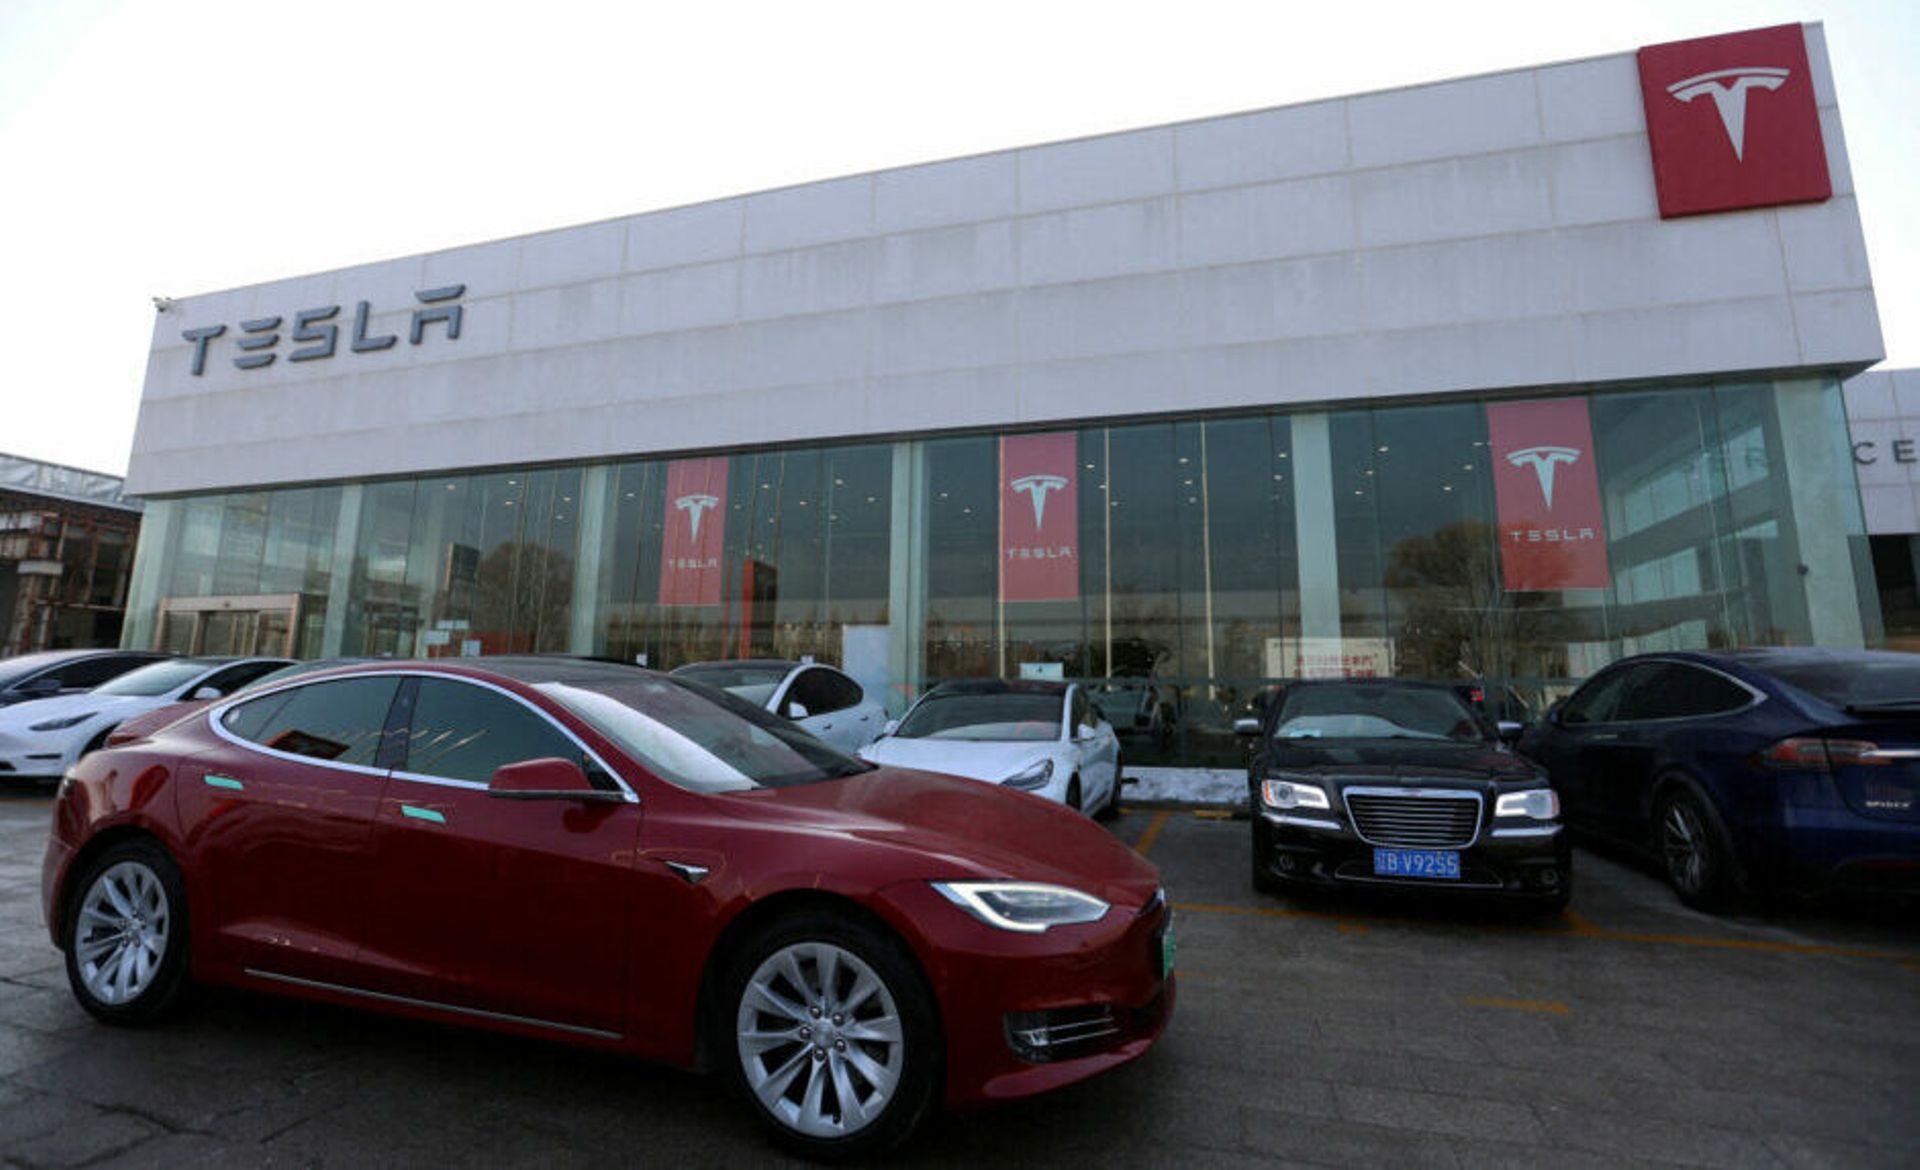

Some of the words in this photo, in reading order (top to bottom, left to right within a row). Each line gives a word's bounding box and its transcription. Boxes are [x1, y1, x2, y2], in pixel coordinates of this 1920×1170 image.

[181, 284, 467, 376] TESLA
[1509, 527, 1595, 542] TESLA
[1008, 546, 1073, 559] TESLA
